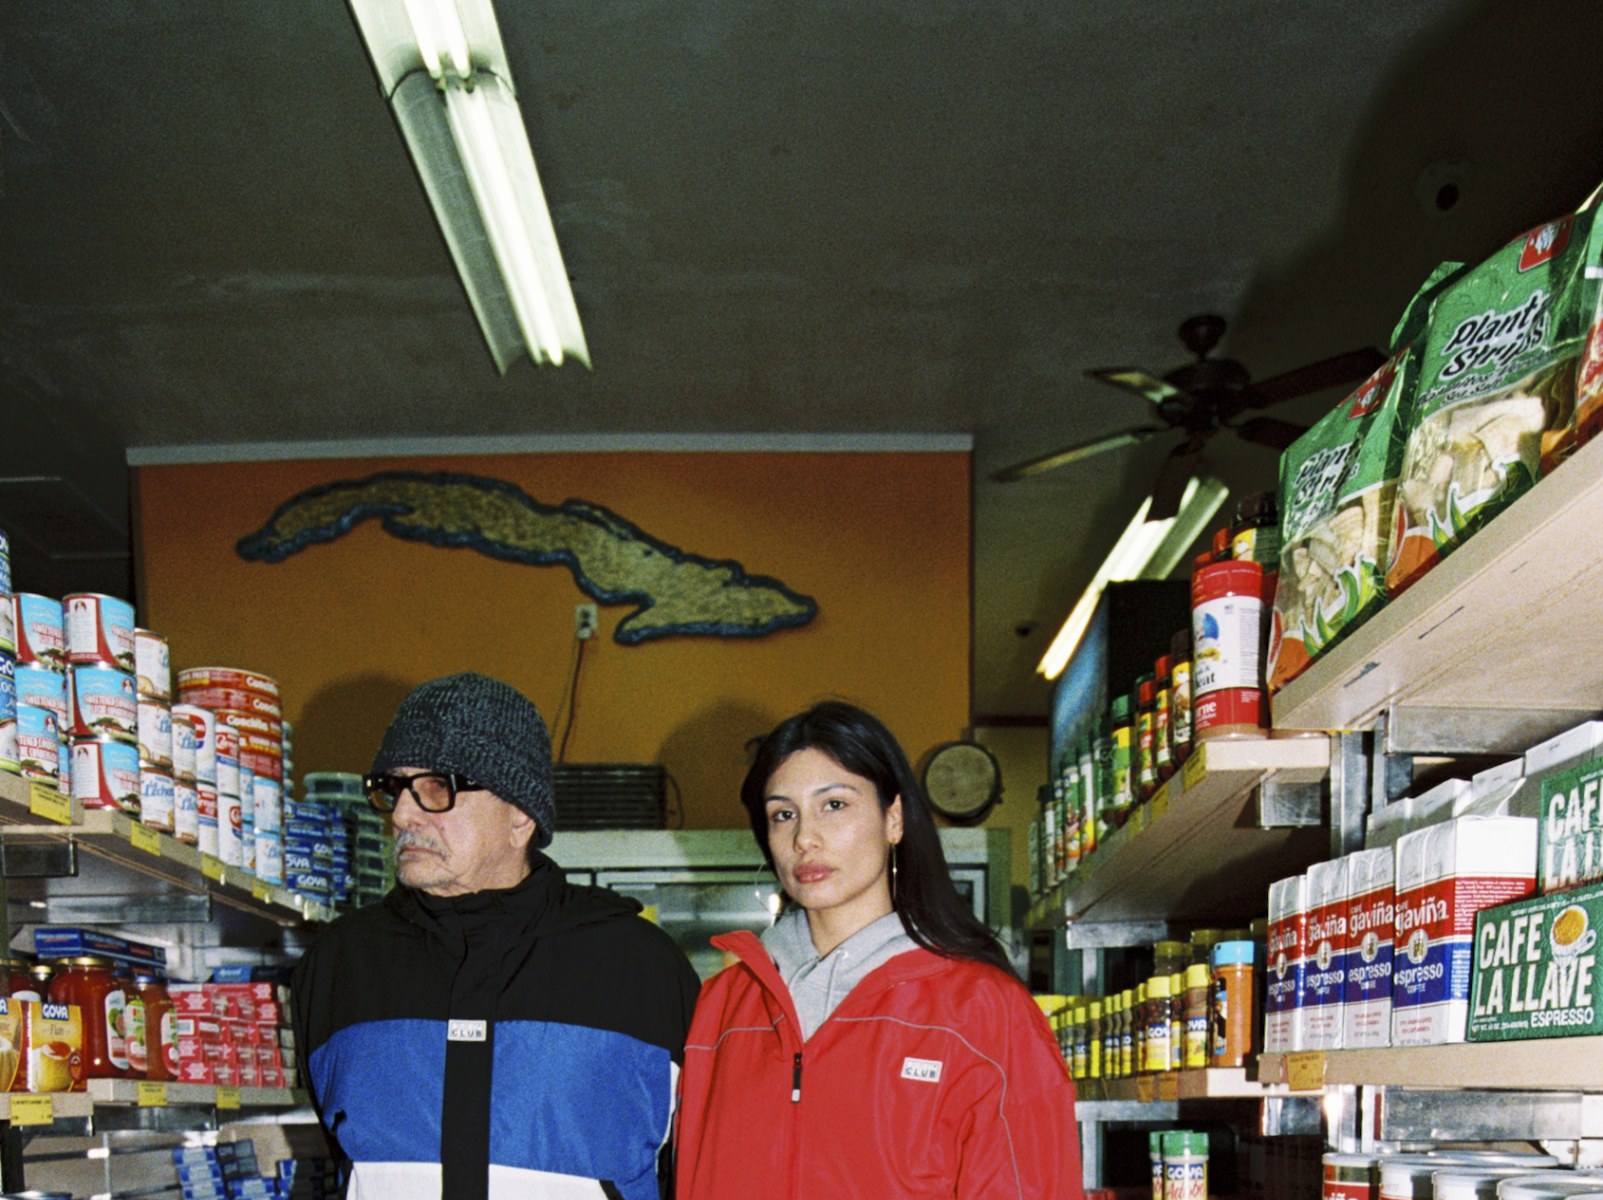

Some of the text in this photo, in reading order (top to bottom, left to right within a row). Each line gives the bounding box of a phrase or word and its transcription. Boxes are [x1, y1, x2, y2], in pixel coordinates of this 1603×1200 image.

[1479, 912, 1544, 970] CAFE
[1348, 962, 1392, 984] espresso
[1474, 968, 1503, 1018] LA
[1510, 955, 1595, 1013] LLAVE
[42, 1003, 69, 1019] GOYA
[1530, 1006, 1594, 1028] ESPRESSO
[452, 1028, 482, 1038] CLUB
[905, 1066, 936, 1079] CLUB
